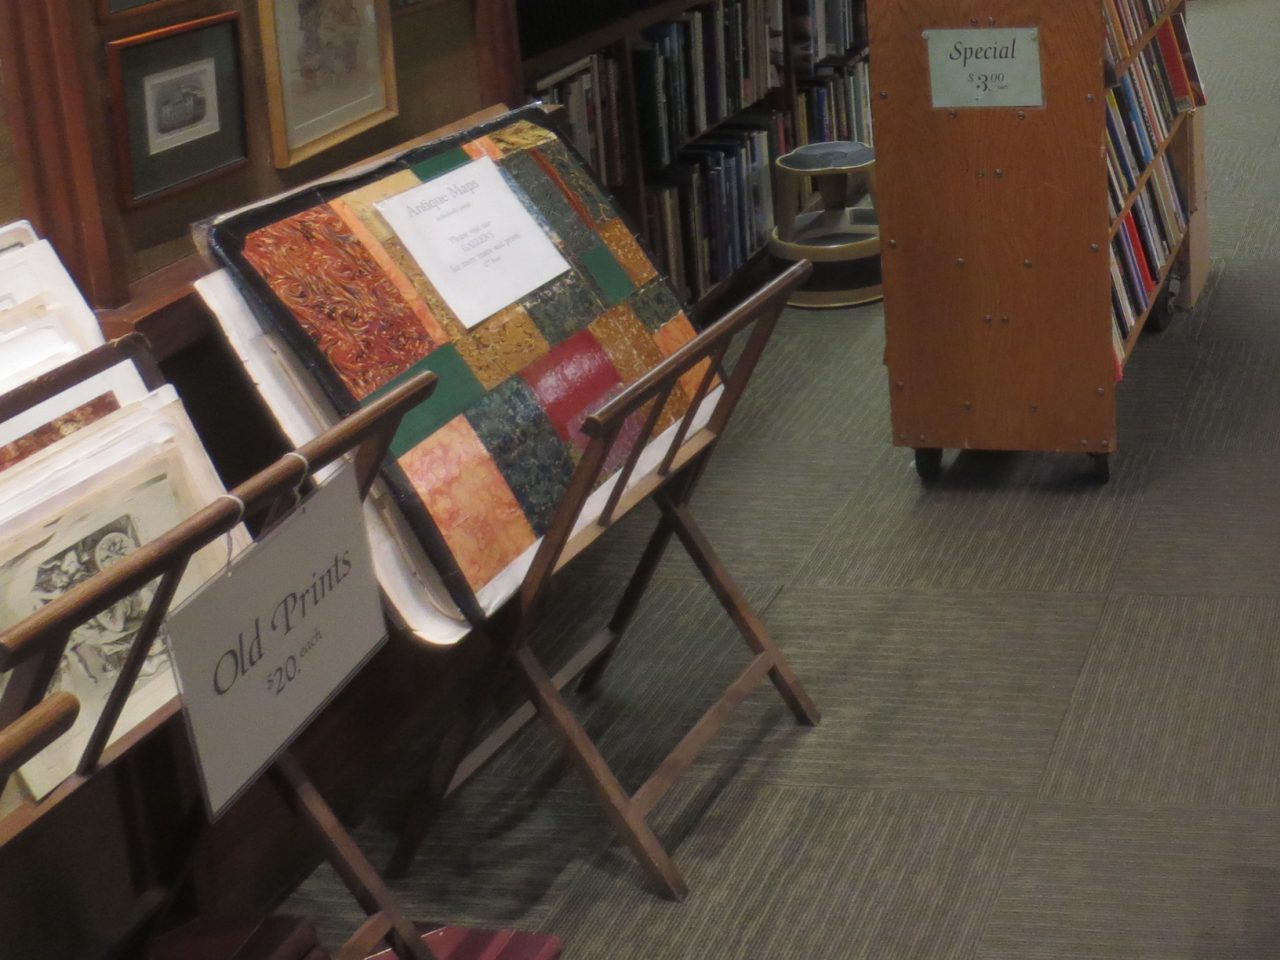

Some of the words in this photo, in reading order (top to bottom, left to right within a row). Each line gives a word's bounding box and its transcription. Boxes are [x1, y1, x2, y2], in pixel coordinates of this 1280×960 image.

[949, 38, 1016, 68] Special
[406, 192, 449, 219] Antique
[447, 178, 481, 199] Maps
[213, 616, 264, 696] Old
[271, 550, 352, 636] Prints
[300, 627, 323, 657] each
